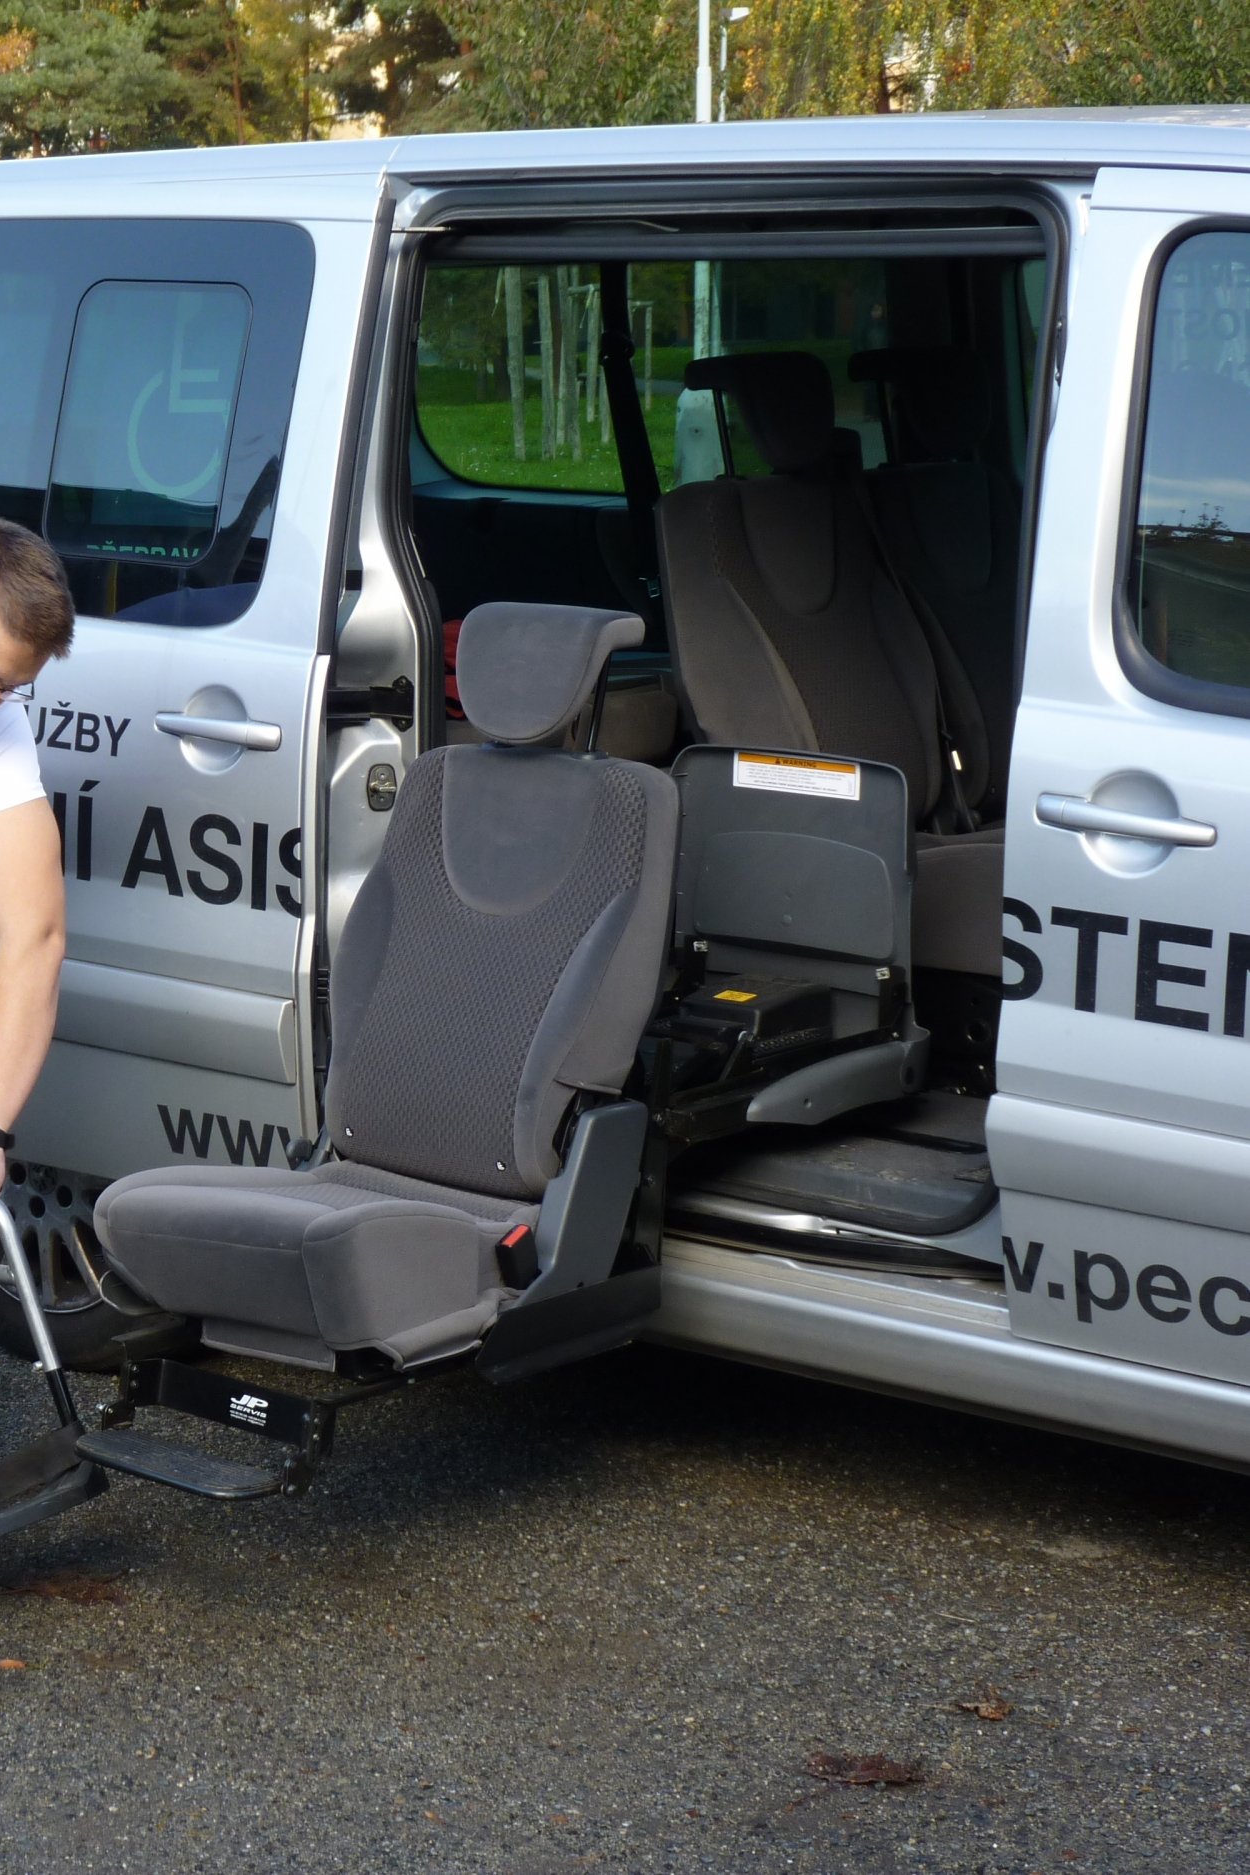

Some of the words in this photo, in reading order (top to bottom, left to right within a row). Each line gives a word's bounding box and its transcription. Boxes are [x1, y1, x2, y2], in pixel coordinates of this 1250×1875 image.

[782, 759, 817, 769] WARNING
[230, 1394, 269, 1409] JP
[230, 1402, 267, 1418] SERVIS
